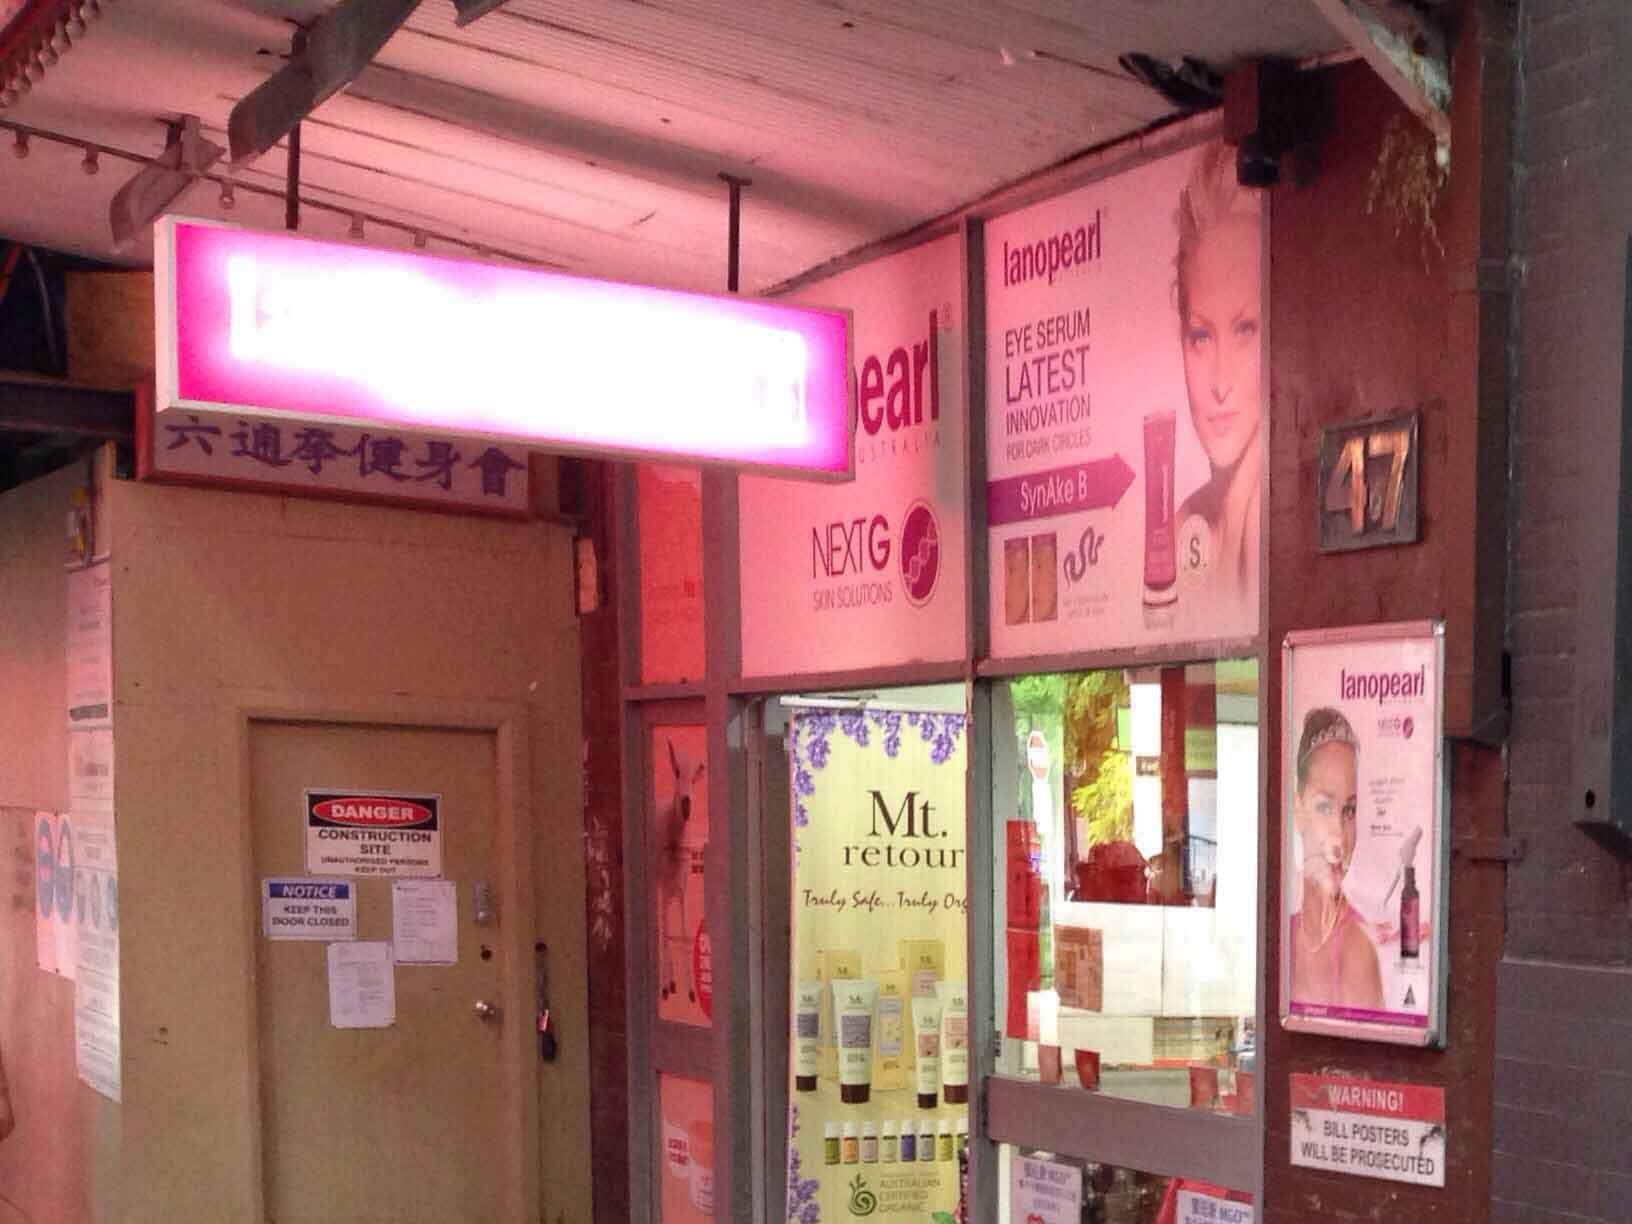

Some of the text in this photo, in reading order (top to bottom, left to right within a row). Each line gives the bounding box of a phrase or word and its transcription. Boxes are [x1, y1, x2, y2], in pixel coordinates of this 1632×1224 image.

[1004, 209, 1101, 287] lanopearl
[1005, 307, 1090, 358] EYE SERUM
[853, 308, 939, 436] earl
[1006, 345, 1090, 403] LATEST
[1006, 394, 1090, 436] INNOVATION
[858, 430, 941, 464] USTRALIA
[1020, 469, 1088, 515] SynAke B
[1325, 429, 1409, 537] 47
[837, 579, 893, 609] SOLUTIONS
[1341, 664, 1425, 706] lanopearl
[331, 804, 414, 820] DANGER
[867, 789, 947, 838] Mt.
[318, 829, 432, 843] CONSTRUCTION
[360, 844, 392, 855] SITE
[843, 843, 964, 868] retour
[281, 884, 337, 899] NOTICE
[803, 889, 846, 913] Truly
[897, 890, 937, 913] Truly
[272, 917, 349, 927] DOOR CLOSED
[284, 905, 337, 915] KEEP THIS
[1327, 1083, 1404, 1113] WARNING!
[1323, 1119, 1410, 1148] BILL POSTERS
[1301, 1141, 1435, 1176] WILL BE PROSECUTED
